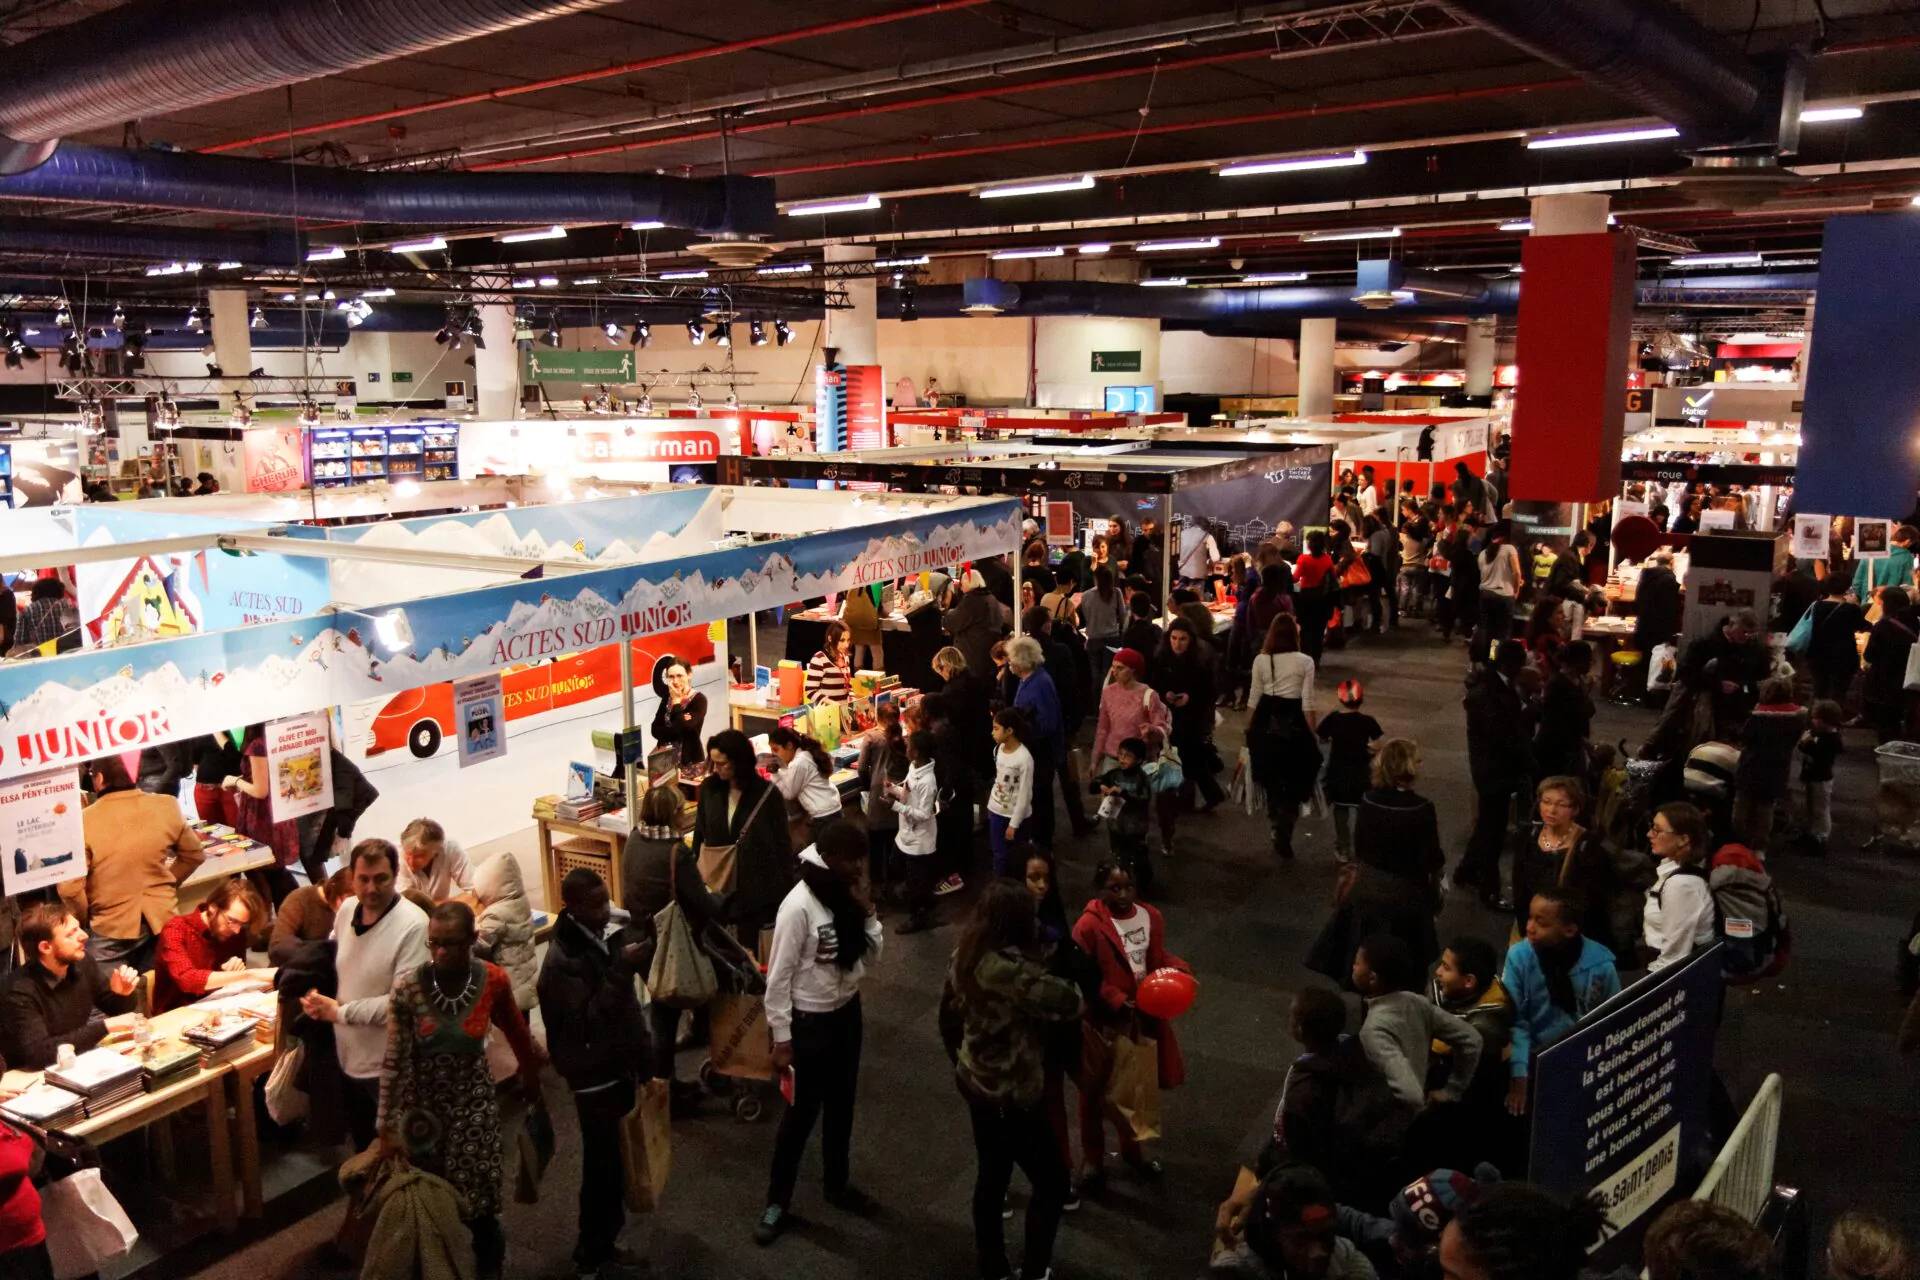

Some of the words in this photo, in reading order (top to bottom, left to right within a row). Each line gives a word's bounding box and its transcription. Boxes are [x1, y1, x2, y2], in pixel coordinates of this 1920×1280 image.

[1627, 392, 1641, 412] G
[1682, 407, 1709, 416] Hatier
[853, 559, 894, 584] ACTES
[898, 554, 922, 572] SUD
[229, 591, 271, 611] ACTES
[275, 596, 303, 614] SUD
[491, 627, 566, 665] ACTES
[572, 617, 615, 647] SUD
[503, 692, 523, 708] TES
[525, 685, 550, 702] SUD
[0, 793, 20, 805] ELSA
[1582, 1070, 1594, 1087] la
[1597, 1010, 1686, 1078] Seine-Saint-Denis
[1587, 1044, 1602, 1061] Le
[1605, 997, 1672, 1051] Département
[1674, 990, 1685, 1006] de
[1587, 1102, 1614, 1128] vous
[1617, 1082, 1643, 1108] offrir
[1644, 1072, 1657, 1089] ce
[1659, 1058, 1677, 1079] sac
[1595, 1078, 1614, 1100] est
[1617, 1050, 1659, 1087] heureux
[1660, 1040, 1672, 1057] de
[1587, 1131, 1599, 1150] et
[1602, 1114, 1628, 1140] vous
[1630, 1081, 1672, 1120] souhaite
[1585, 1150, 1607, 1172] une
[1610, 1125, 1642, 1156] bonne
